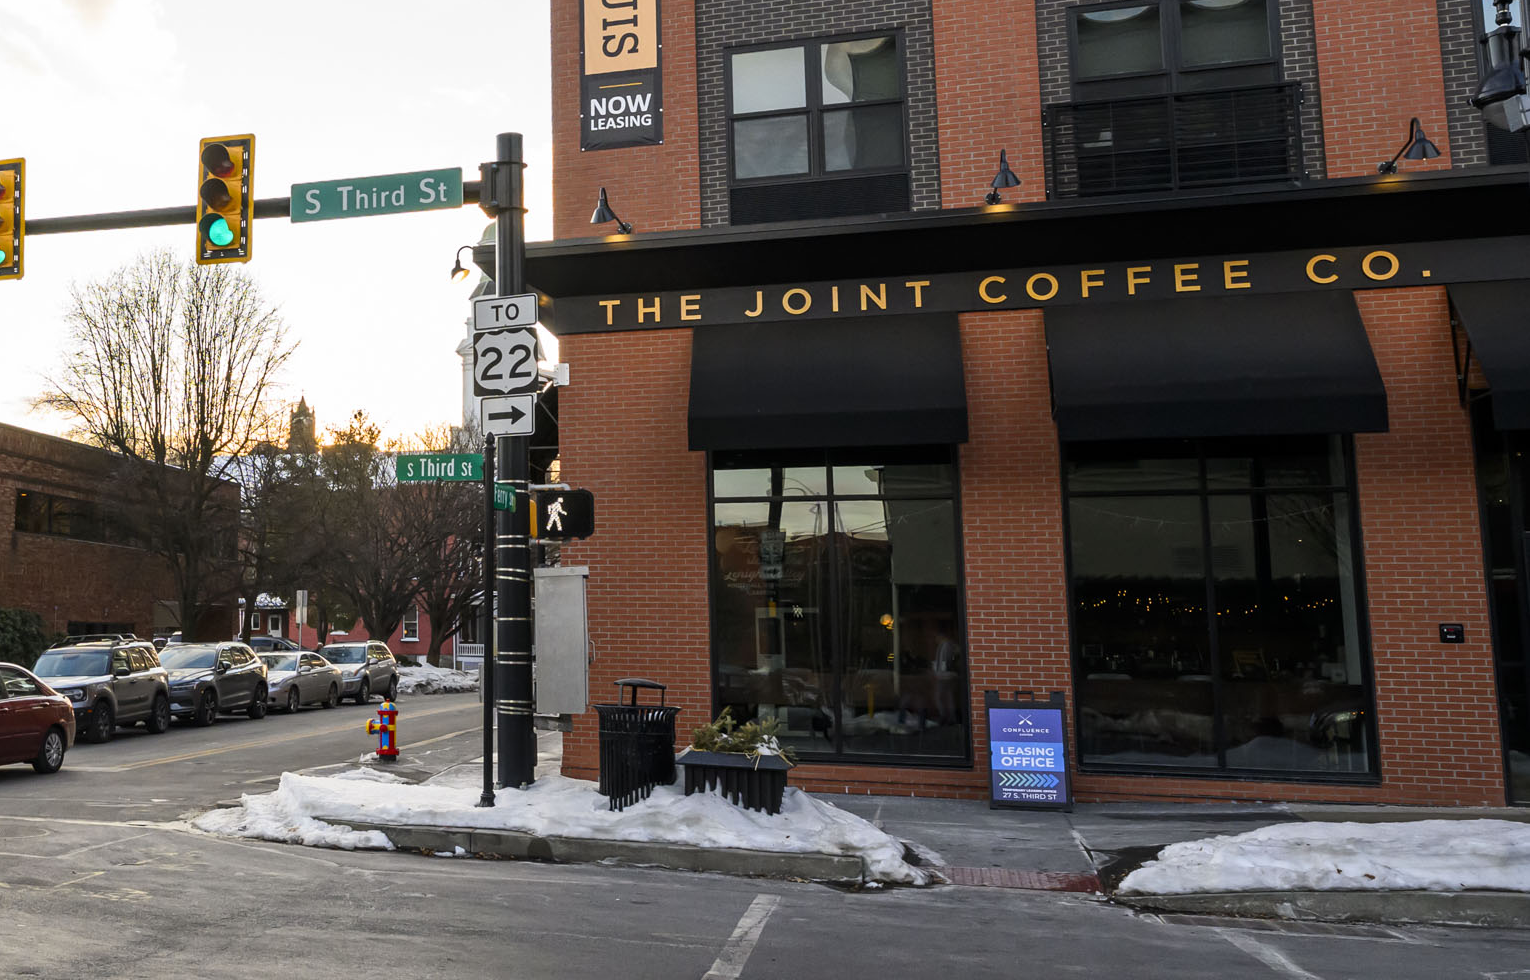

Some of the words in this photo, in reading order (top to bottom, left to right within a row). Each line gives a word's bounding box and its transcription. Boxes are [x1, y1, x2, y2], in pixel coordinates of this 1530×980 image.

[590, 93, 651, 116] NOW
[591, 114, 652, 131] LEASING
[305, 189, 320, 214] S
[337, 185, 405, 210] Third
[420, 178, 447, 203] St
[598, 294, 702, 325] THE
[744, 280, 930, 317] JOINT
[978, 260, 1251, 304] COFFEE
[1306, 250, 1430, 284] CO.
[491, 303, 519, 322] TO
[480, 344, 532, 381] 22
[407, 462, 414, 477] S
[420, 458, 454, 477] Third
[461, 462, 472, 476] St
[494, 484, 508, 508] Ferry
[1000, 747, 1054, 756] LEASING
[1001, 757, 1054, 768] OFFICE
